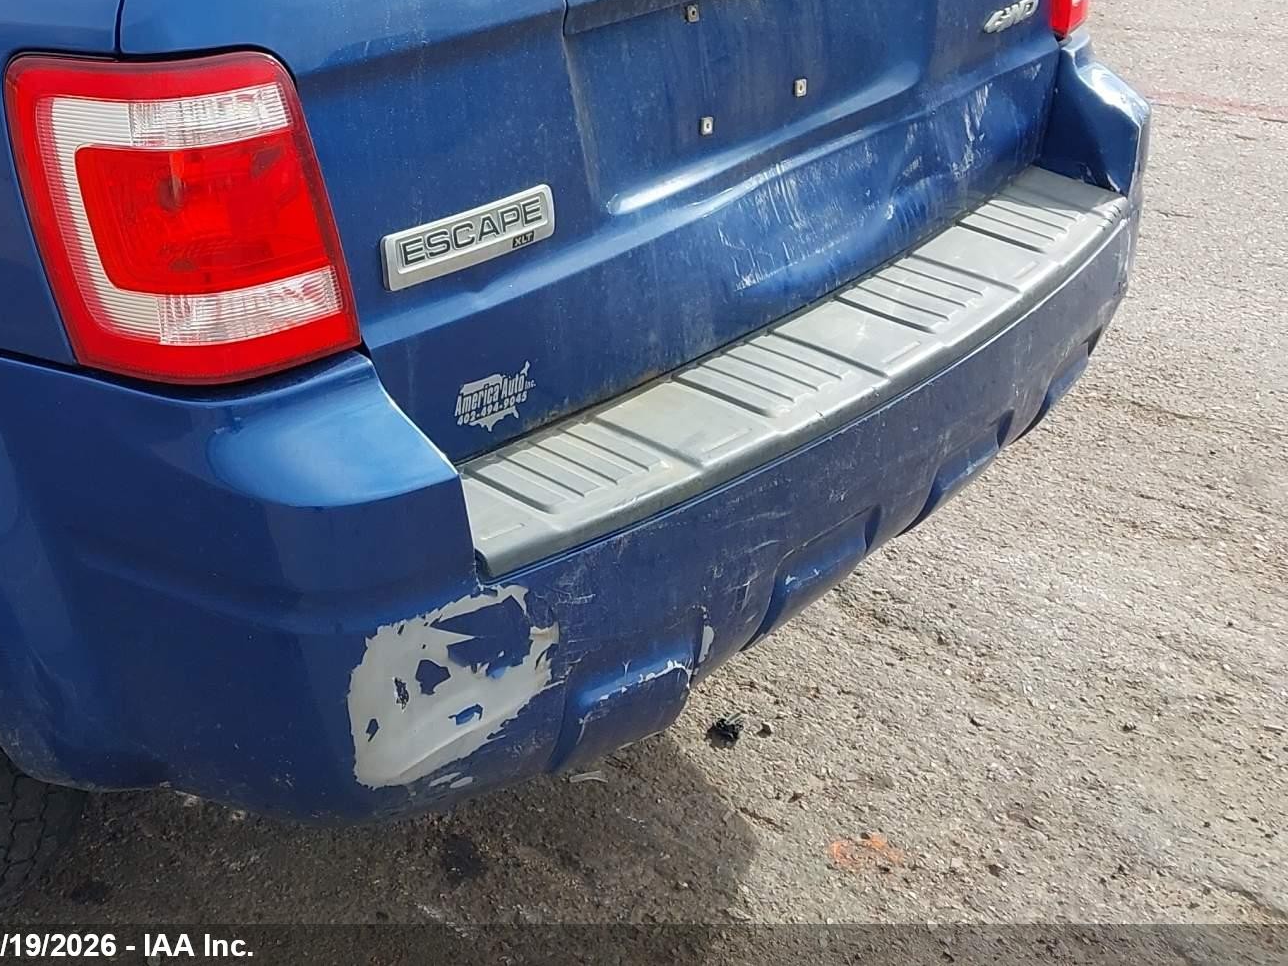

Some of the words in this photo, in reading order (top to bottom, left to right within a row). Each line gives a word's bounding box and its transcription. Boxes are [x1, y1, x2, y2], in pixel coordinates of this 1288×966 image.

[401, 197, 543, 266] ESCAPE
[513, 233, 534, 248] XLT
[455, 384, 500, 416] America
[501, 374, 525, 400] Auto
